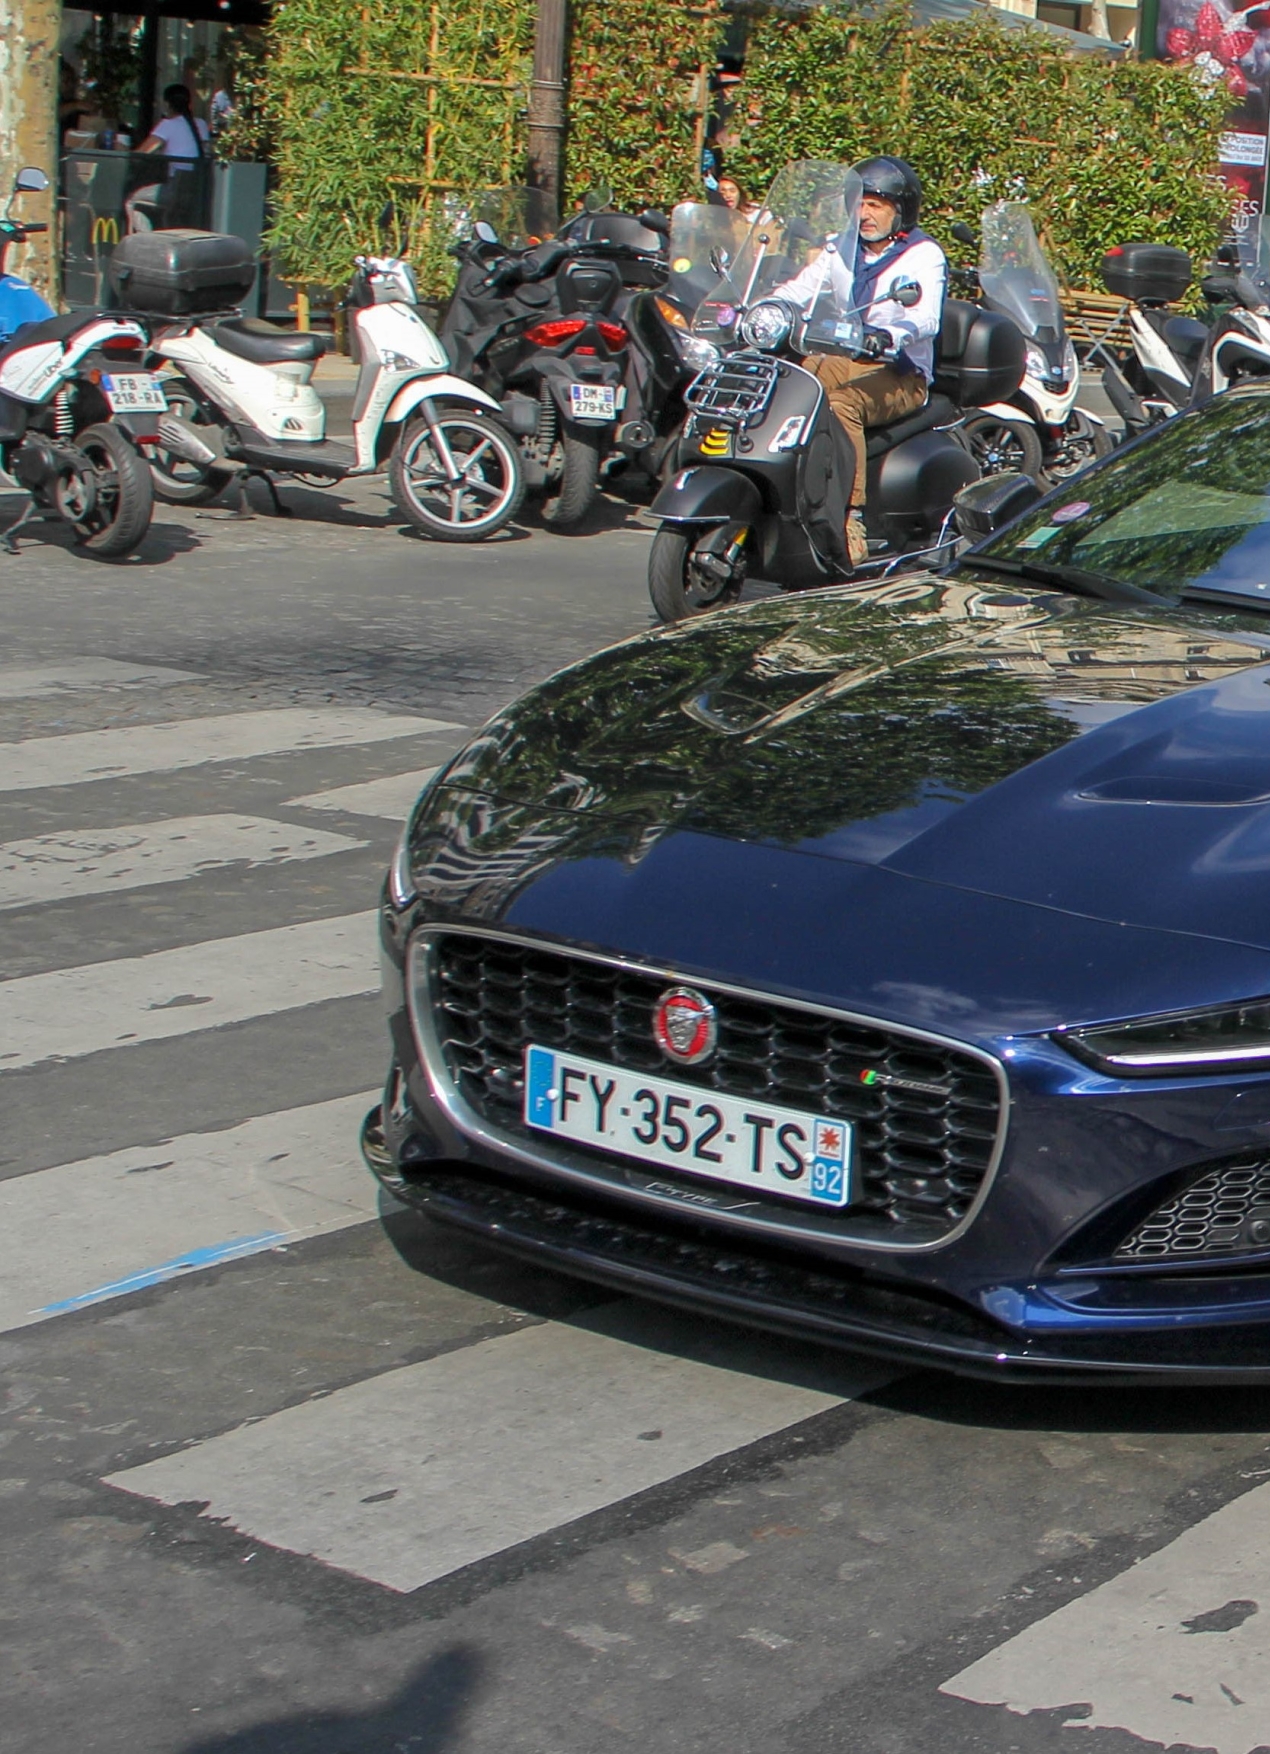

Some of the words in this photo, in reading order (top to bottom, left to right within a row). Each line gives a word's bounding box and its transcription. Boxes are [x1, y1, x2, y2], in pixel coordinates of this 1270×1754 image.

[574, 401, 613, 414] 279-KS
[559, 1066, 808, 1181] FY-352-TS
[813, 1162, 841, 1195] 92
